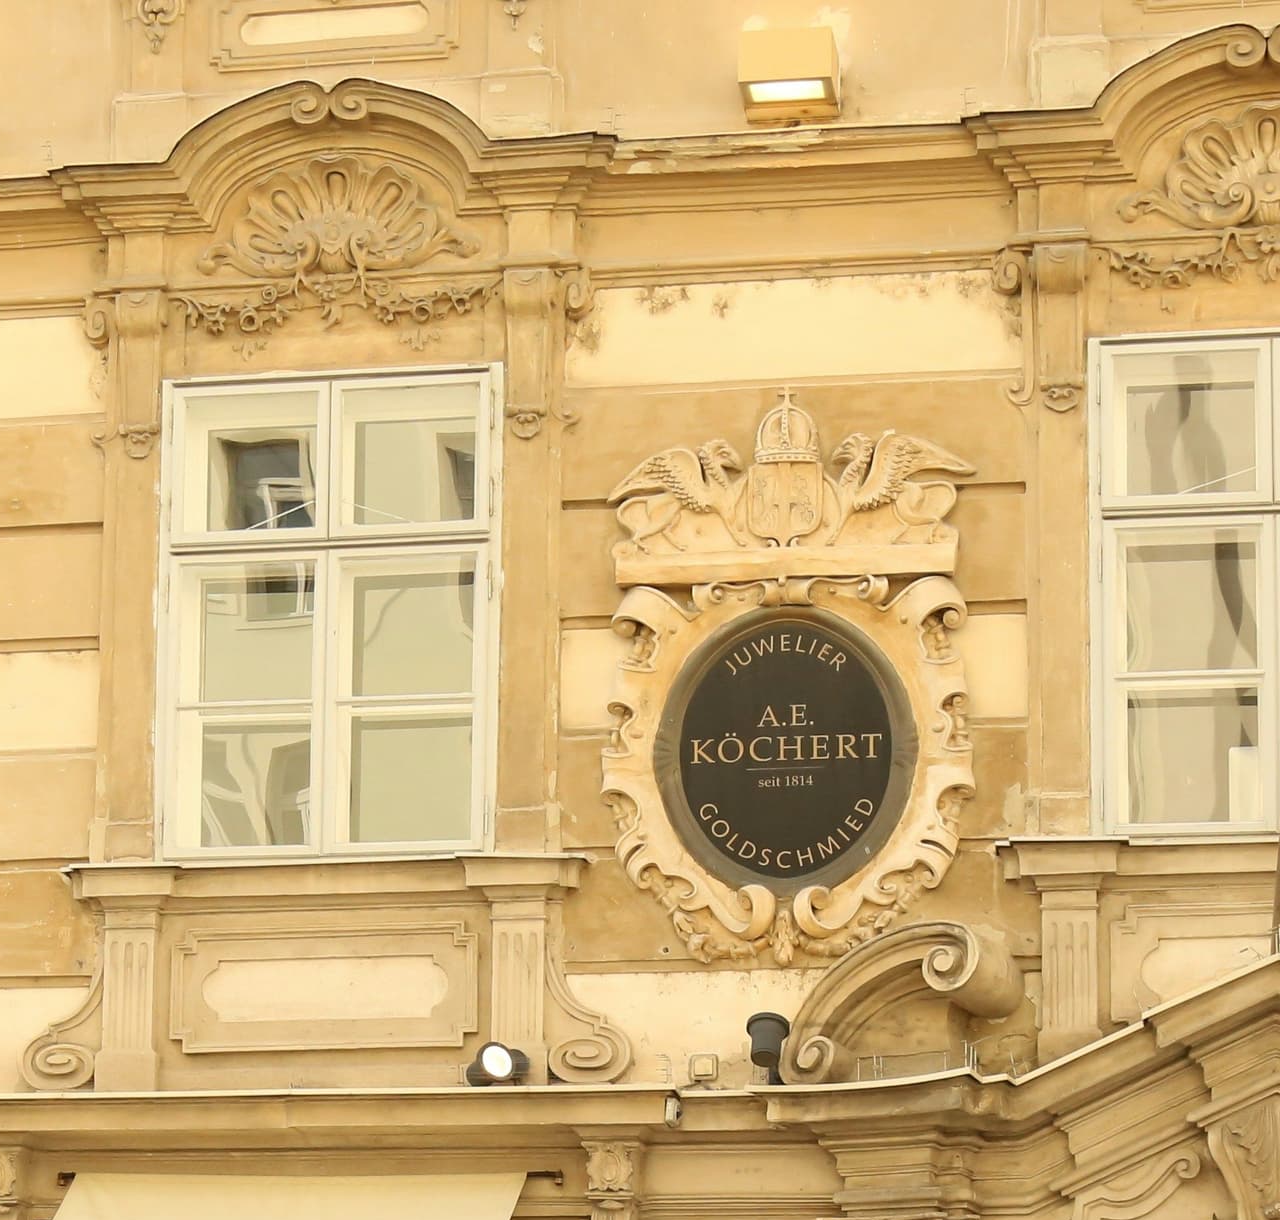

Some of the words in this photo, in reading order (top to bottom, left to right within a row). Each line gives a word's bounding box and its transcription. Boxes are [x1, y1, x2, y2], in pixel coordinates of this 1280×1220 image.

[724, 634, 847, 675] JUWELIER
[756, 704, 815, 728] A.E.
[690, 732, 882, 765] KÖCHERT
[758, 776, 780, 788] seit
[784, 775, 814, 788] 1814
[699, 798, 874, 869] GOLDSCHMIED
